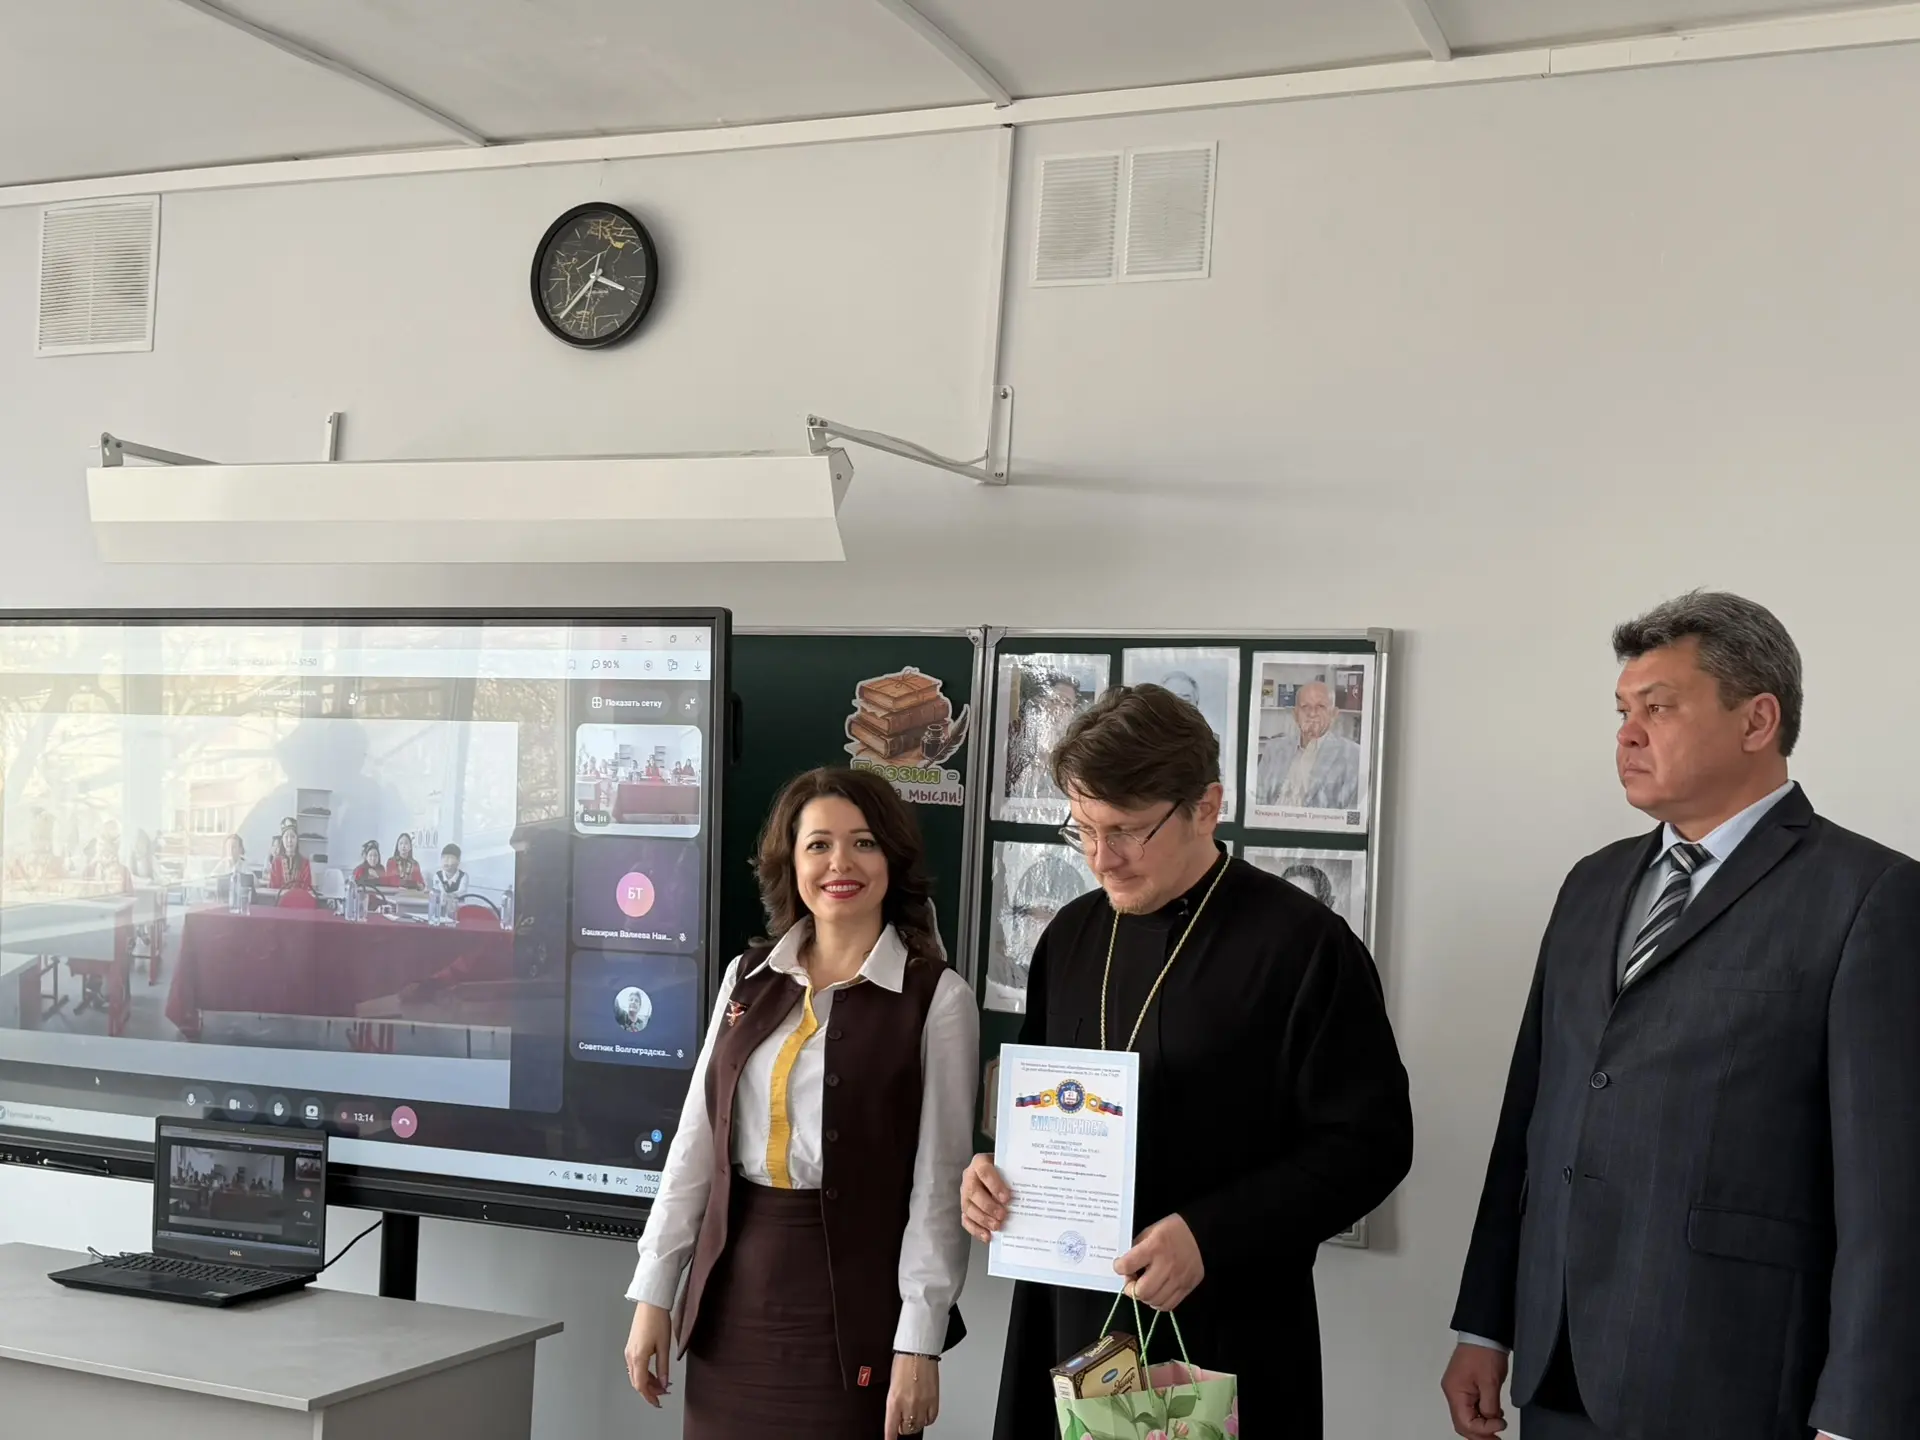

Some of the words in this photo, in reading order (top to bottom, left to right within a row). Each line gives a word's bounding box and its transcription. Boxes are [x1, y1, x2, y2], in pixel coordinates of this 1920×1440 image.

[605, 698, 640, 707] Показать
[641, 700, 662, 708] сетку
[627, 887, 644, 900] БТ
[581, 928, 618, 938] Башкирия
[579, 1041, 614, 1053] Советник
[354, 1112, 374, 1123] 13:14
[615, 1176, 628, 1185] РУС
[643, 1173, 660, 1183] 10:22
